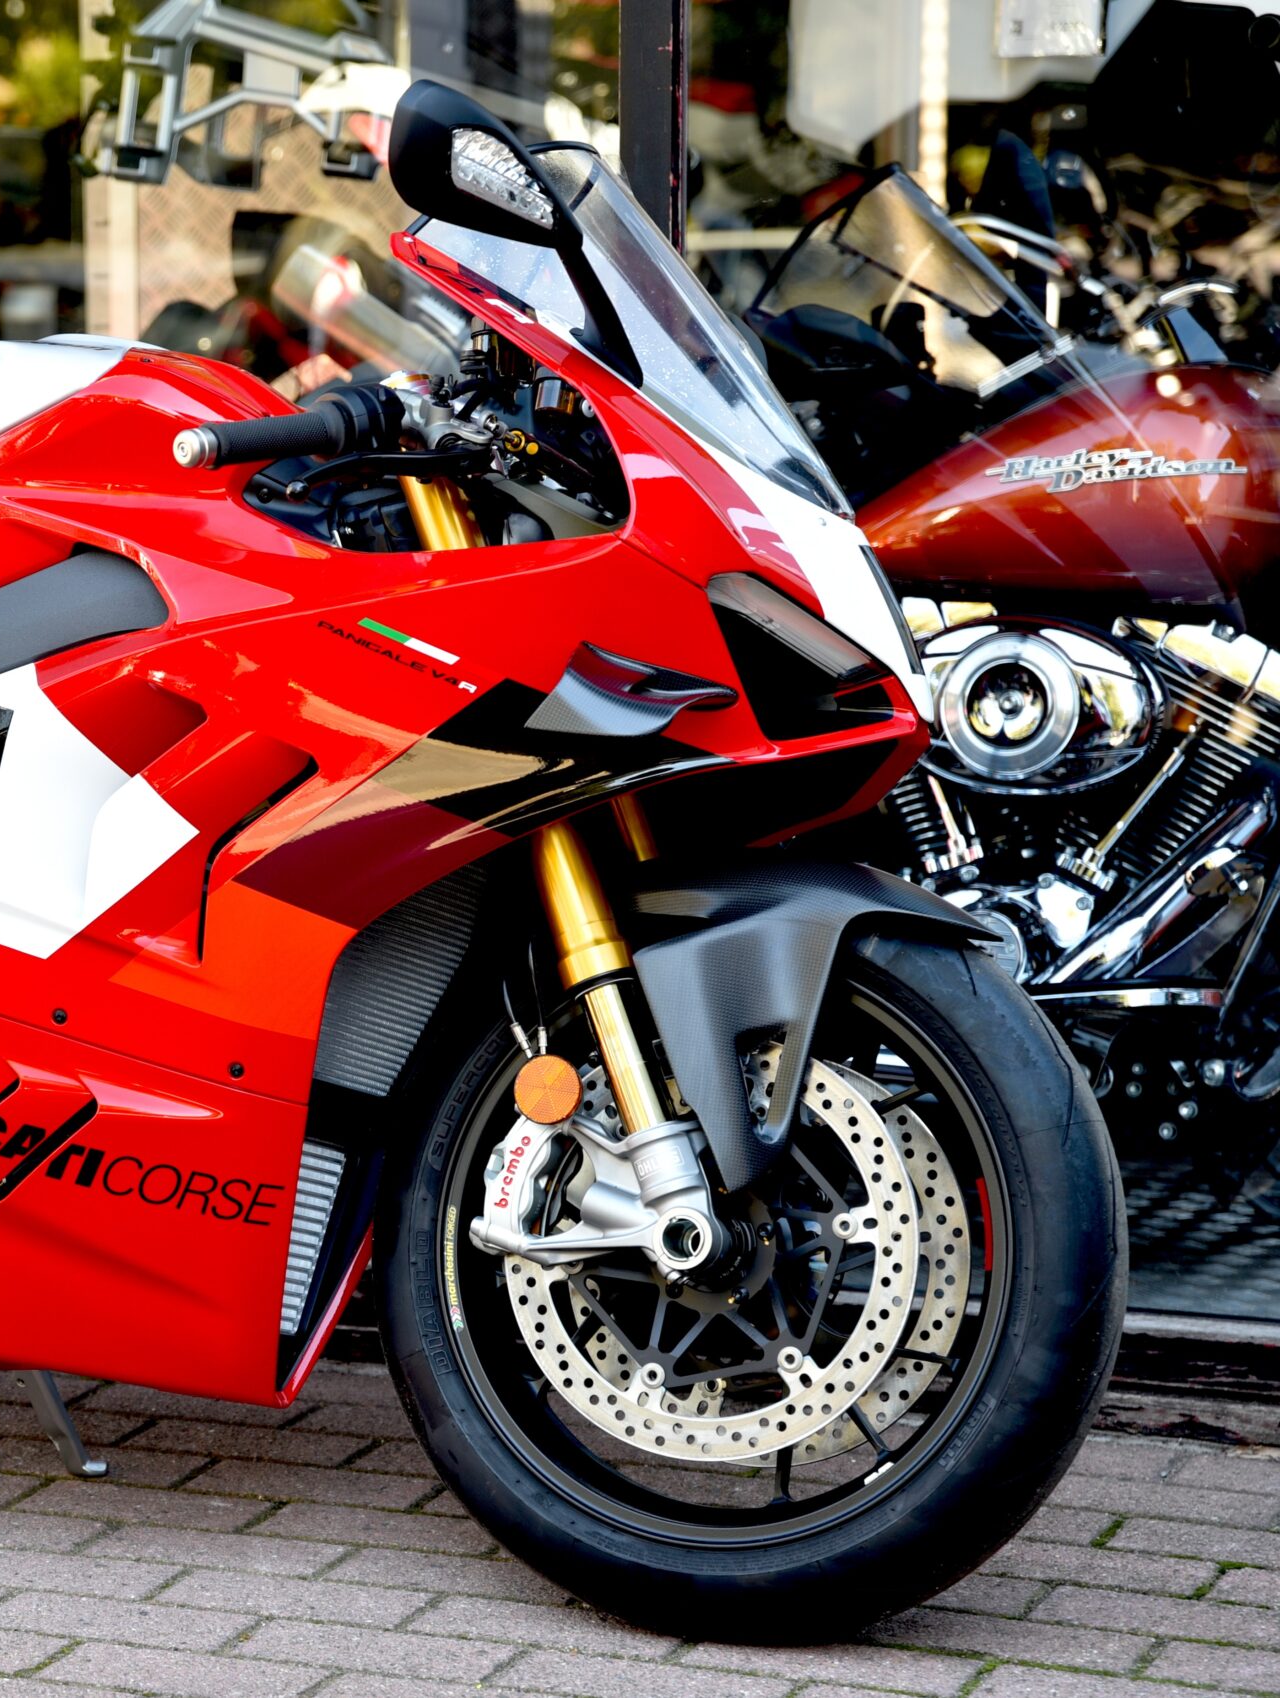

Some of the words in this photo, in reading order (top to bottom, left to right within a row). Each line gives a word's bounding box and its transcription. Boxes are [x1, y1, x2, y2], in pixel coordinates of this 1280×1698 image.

[996, 448, 1150, 483] Harley
[1046, 456, 1246, 493] Davidson
[316, 619, 429, 673] PANIGALE
[431, 1028, 509, 1158] SUPERCOR
[102, 1155, 286, 1226] CORSE
[493, 1135, 532, 1209] brembo
[637, 1150, 681, 1177] ÖHLS
[446, 1206, 457, 1241] FORGED
[415, 1230, 453, 1376] DIABLO
[444, 1241, 459, 1306] marchesini
[938, 1393, 997, 1472] PIRELLI
